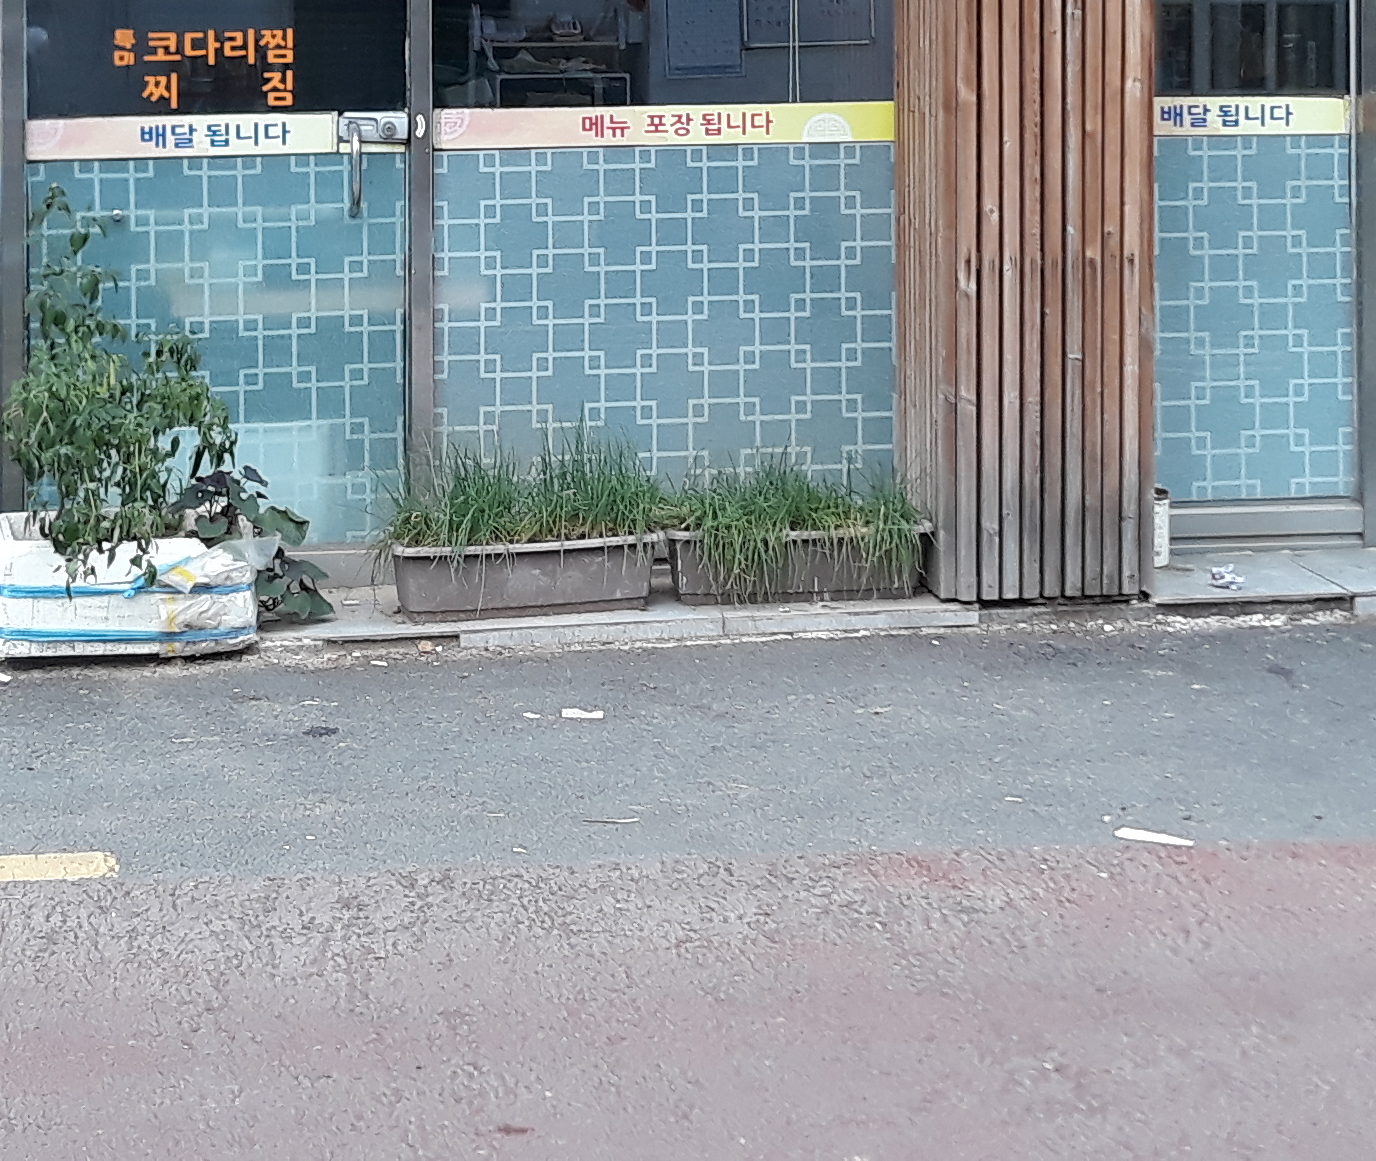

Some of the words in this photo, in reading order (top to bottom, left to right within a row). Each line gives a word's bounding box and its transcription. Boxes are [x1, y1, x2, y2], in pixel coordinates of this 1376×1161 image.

[142, 27, 296, 66] 코다리찜
[581, 112, 630, 138] 메뉴
[643, 111, 694, 137] 포장
[700, 110, 774, 137] 됩니다
[1159, 103, 1212, 128] 배달
[1216, 103, 1294, 128] 됩니다
[139, 122, 198, 150] 배달
[204, 121, 292, 148] 됩니다
